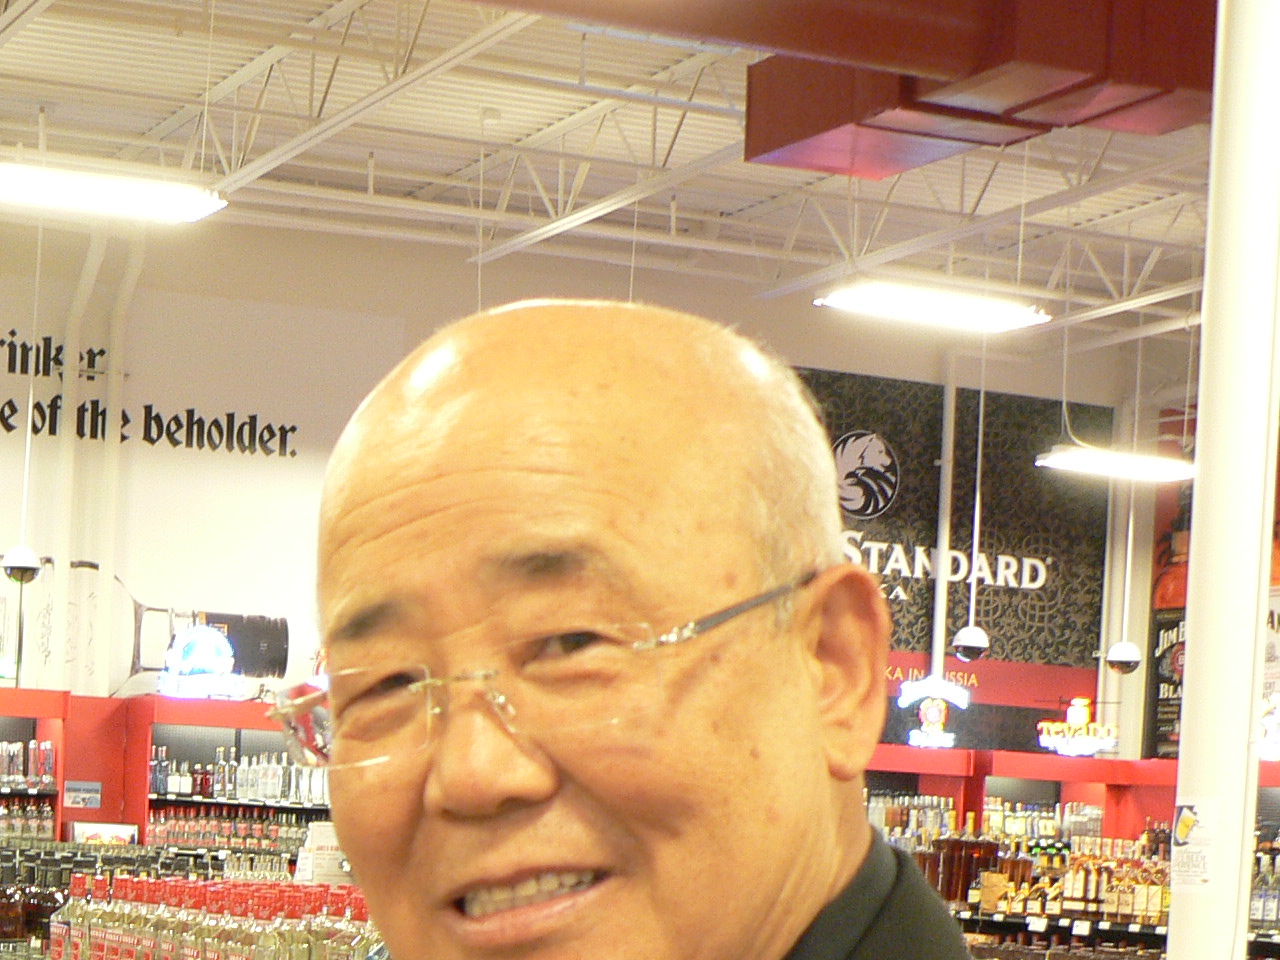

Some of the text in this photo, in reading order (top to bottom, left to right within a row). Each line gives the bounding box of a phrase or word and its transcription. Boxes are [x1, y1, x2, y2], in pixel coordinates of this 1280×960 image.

[30, 394, 63, 436] of
[142, 404, 298, 458] beholder.
[841, 530, 1048, 590] STANDARD
[1154, 626, 1179, 658] JIM
[908, 667, 925, 681] IN
